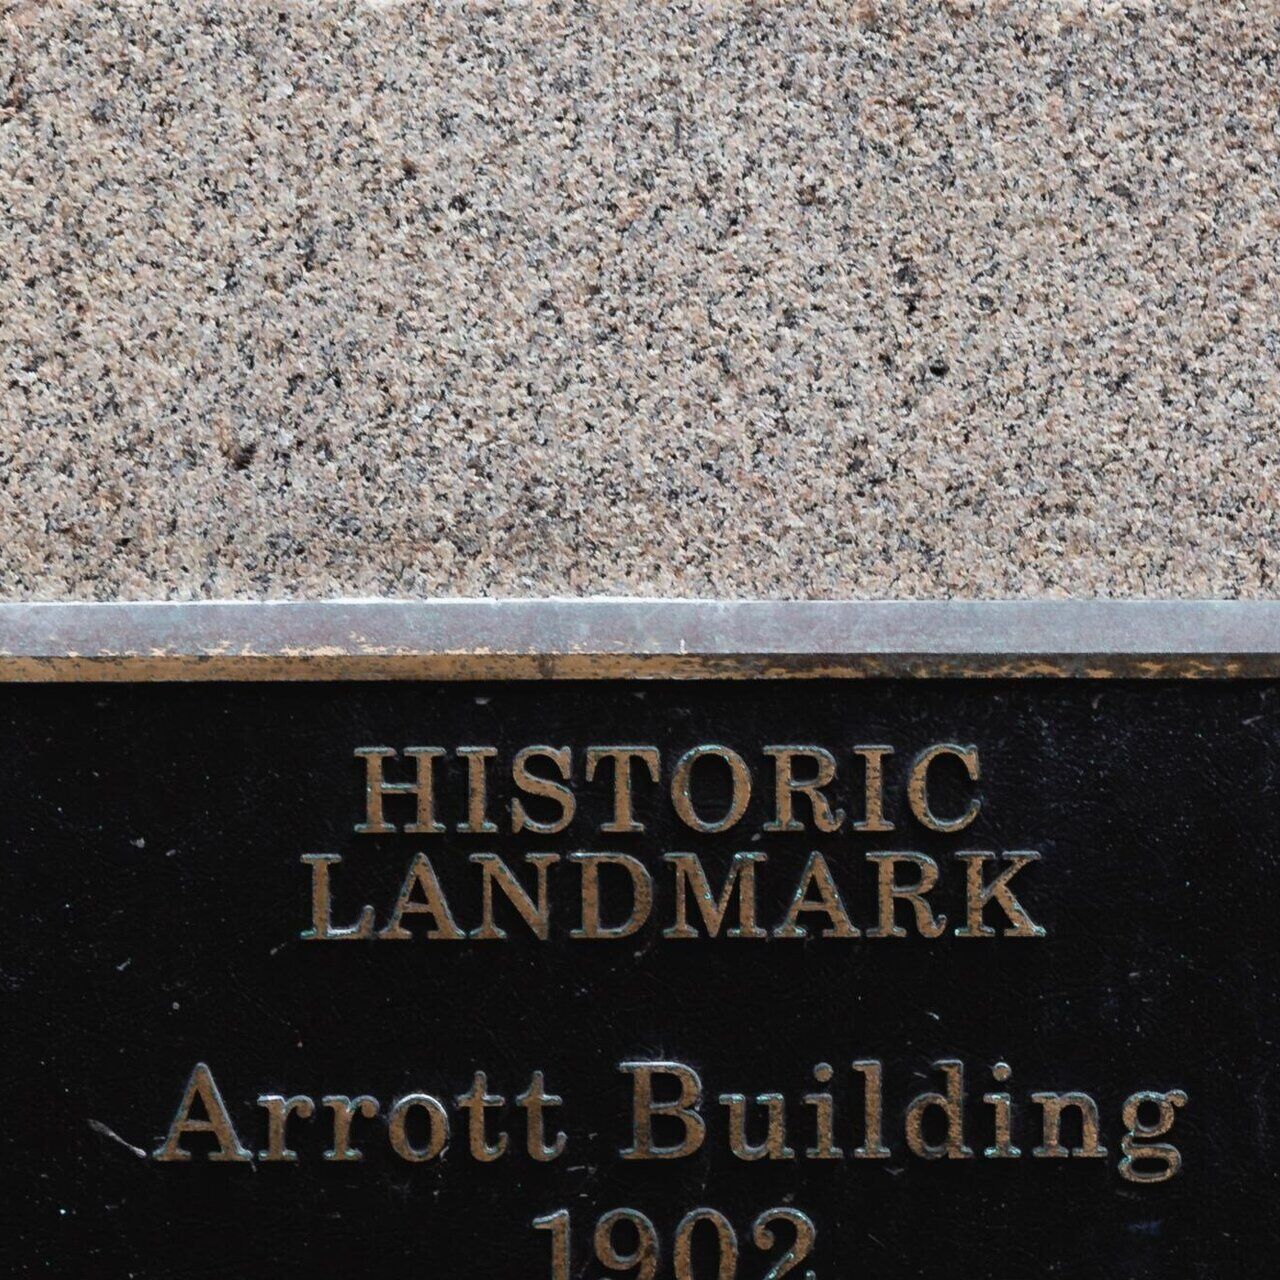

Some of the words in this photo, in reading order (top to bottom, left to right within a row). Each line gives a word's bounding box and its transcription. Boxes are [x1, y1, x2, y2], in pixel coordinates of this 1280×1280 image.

[352, 742, 982, 835] HISTORIC
[299, 850, 1048, 942] LANDMARK
[153, 1059, 567, 1164] Arrott
[619, 1057, 1190, 1183] Building
